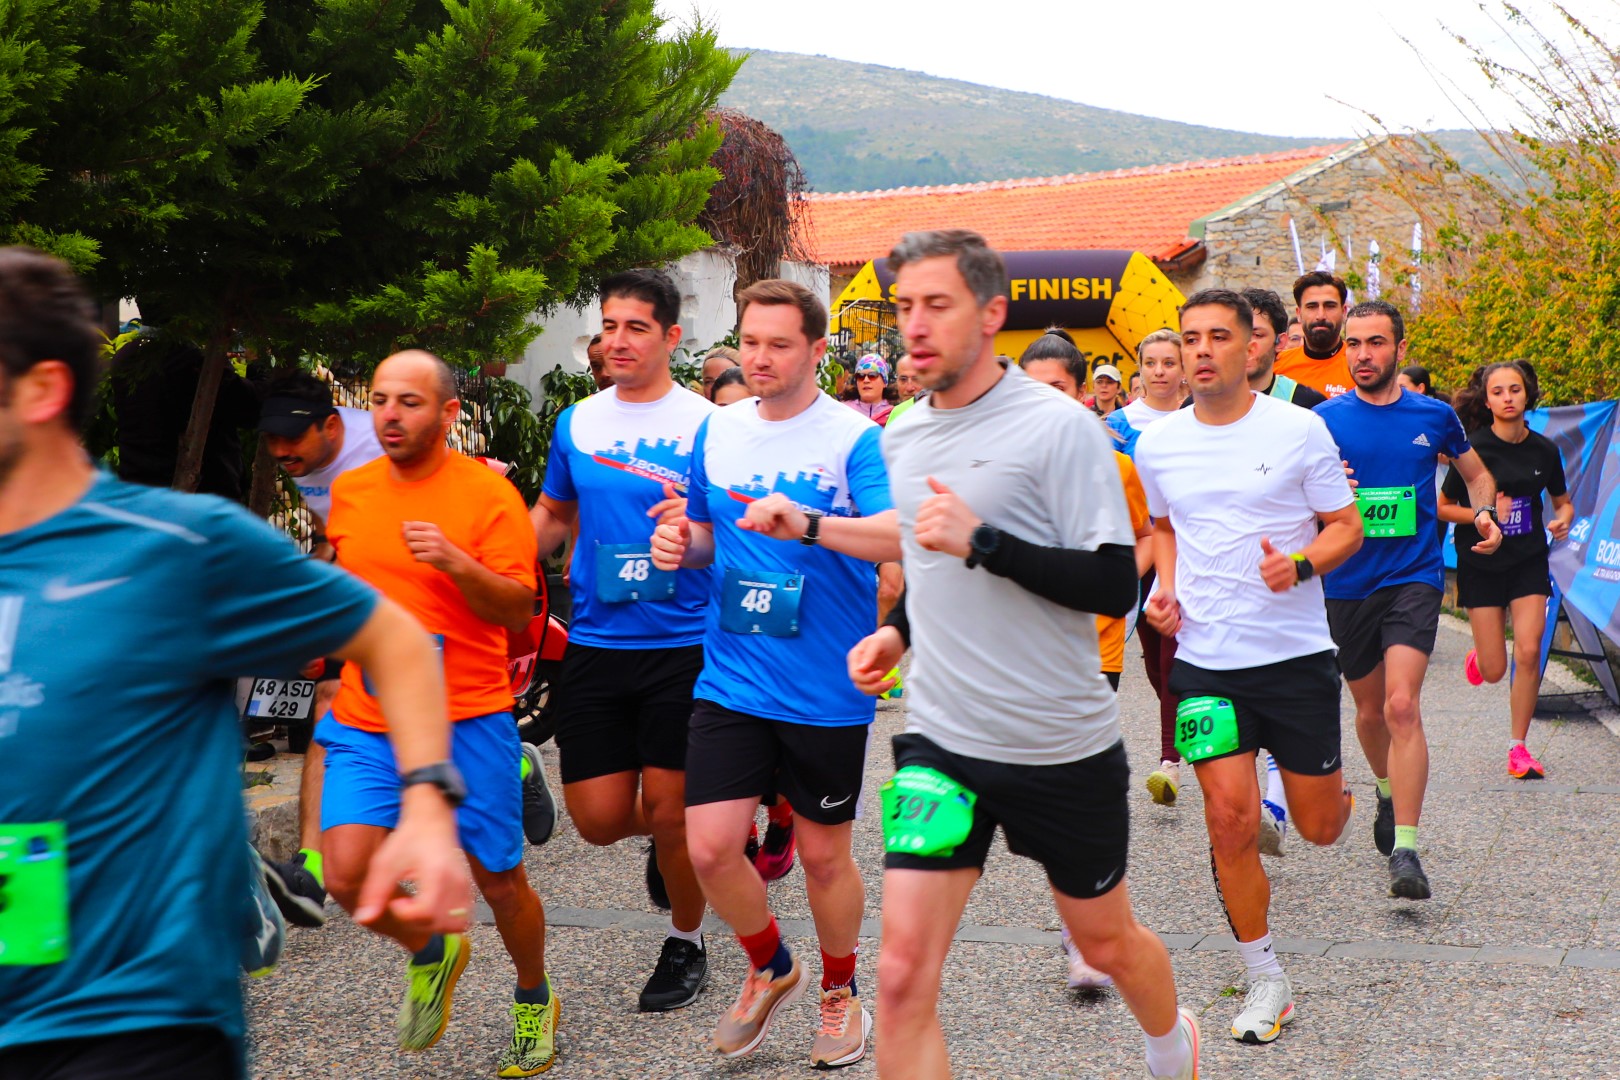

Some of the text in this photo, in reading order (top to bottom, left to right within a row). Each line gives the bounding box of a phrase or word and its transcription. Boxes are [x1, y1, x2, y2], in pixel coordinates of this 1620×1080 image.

[1010, 277, 1113, 301] FINISH
[1363, 503, 1398, 521] 401
[618, 559, 650, 582] 48
[740, 588, 772, 613] 48
[256, 680, 314, 698] 48 ASD
[268, 701, 299, 717] 429
[1180, 715, 1214, 743] 390
[891, 795, 941, 824] 391
